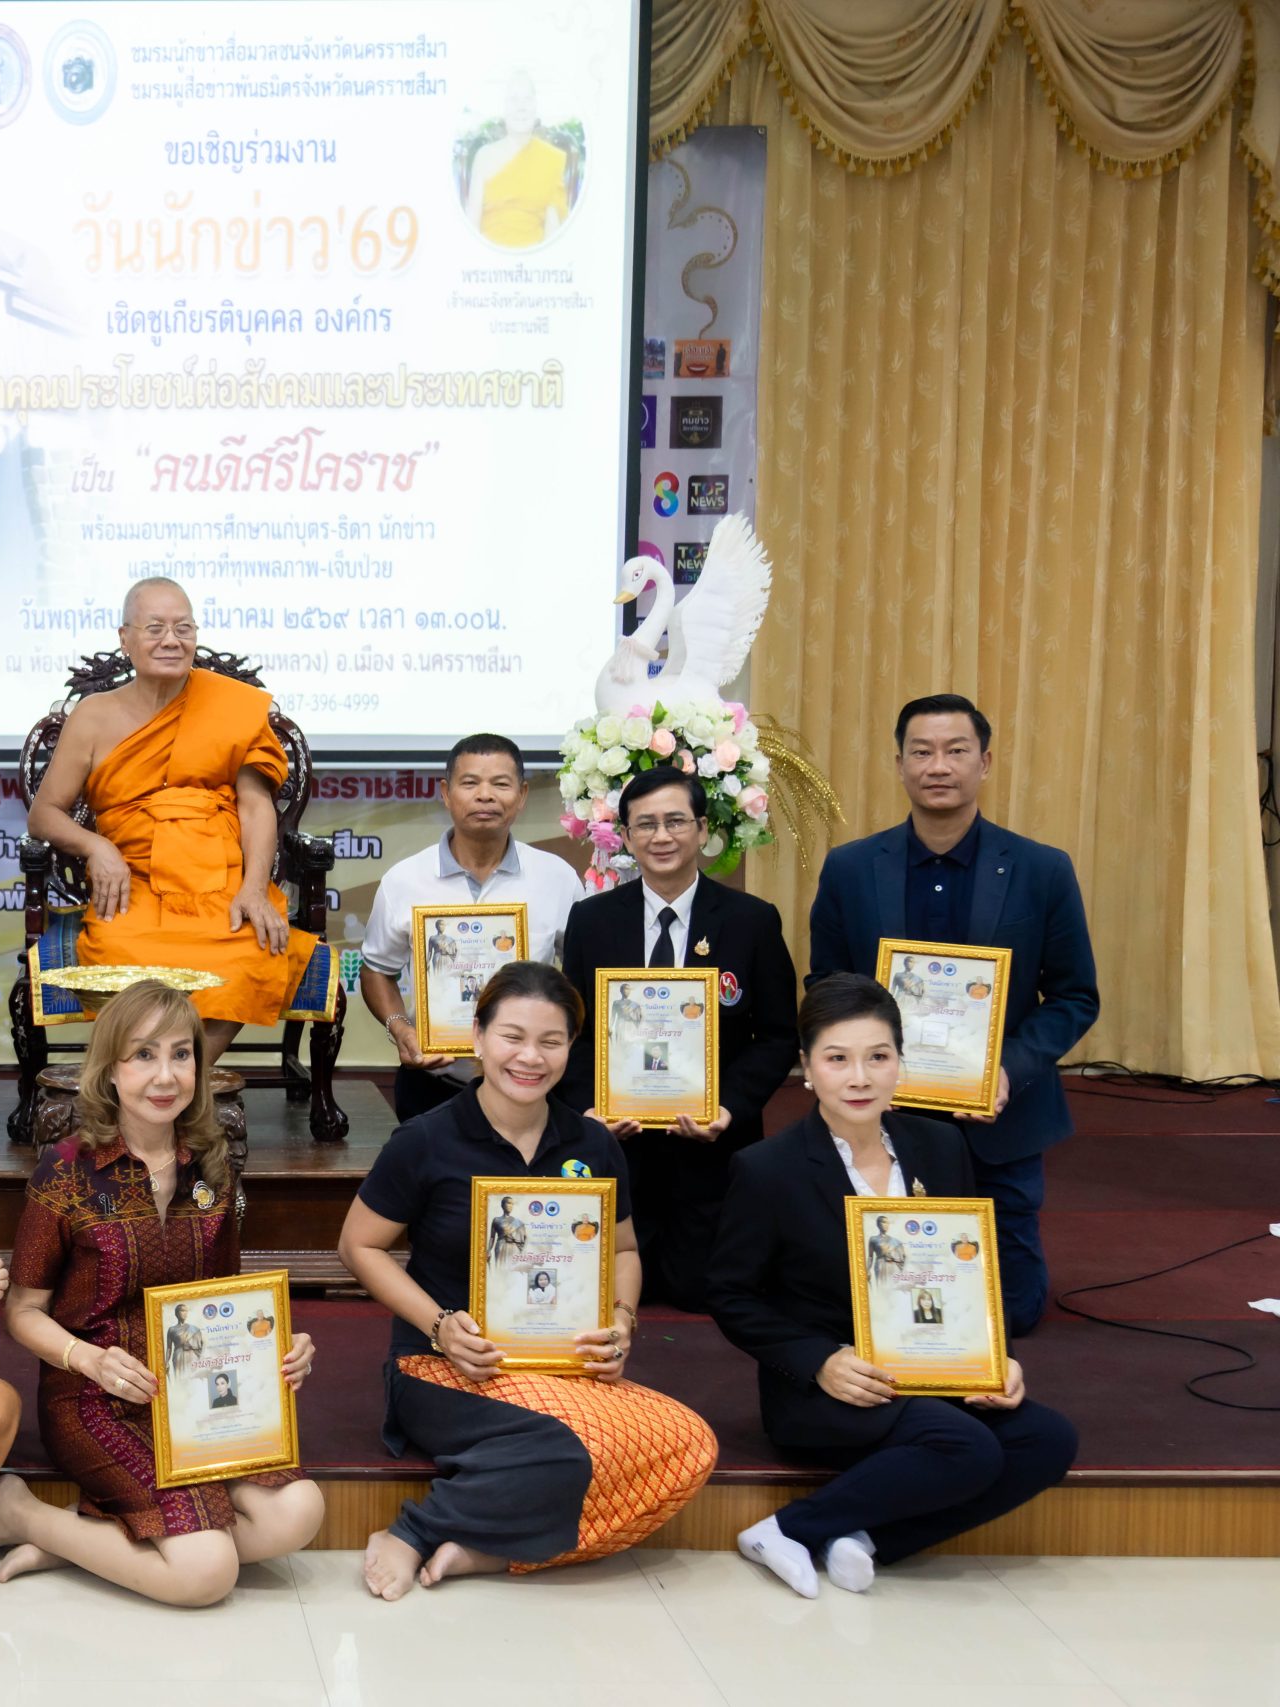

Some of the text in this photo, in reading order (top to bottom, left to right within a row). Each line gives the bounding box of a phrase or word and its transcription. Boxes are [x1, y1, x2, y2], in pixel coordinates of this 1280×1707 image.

[164, 129, 337, 174] ขอเชิญร่วมงาน
[107, 293, 393, 346] เชิดชูเกียรติบุคคล องค์กร
[69, 451, 114, 494] เป็น
[691, 482, 725, 496] TOP
[691, 496, 725, 507] NEWS
[80, 513, 435, 547] พร้อมมอบทุนการศึกษาแก่บุตร-ธิดา นักข่าว
[677, 560, 704, 569] NEW
[19, 598, 122, 638] วันพฤหัสบ
[202, 599, 273, 631] มีนาคม
[284, 607, 349, 631] ๒๕๖๙
[359, 606, 406, 631] เวลา
[336, 645, 394, 673] อ.เมือง
[402, 645, 523, 673] จ.นครราชสีมา
